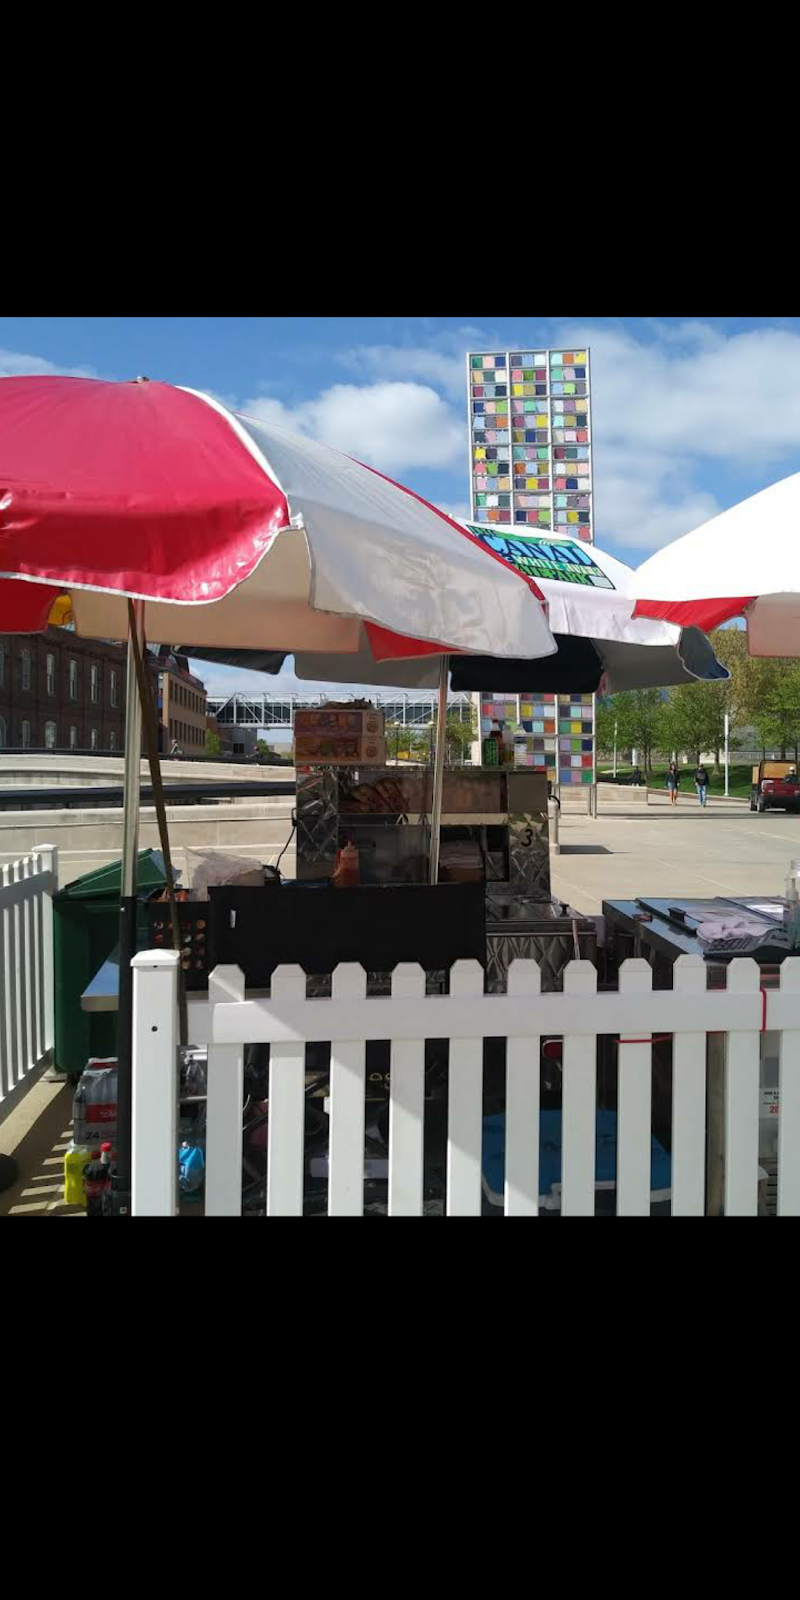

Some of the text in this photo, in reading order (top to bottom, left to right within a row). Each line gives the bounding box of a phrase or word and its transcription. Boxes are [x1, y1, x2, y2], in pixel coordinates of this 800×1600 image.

[478, 533, 598, 567] CANAL
[511, 555, 564, 571] WHITE
[551, 569, 595, 586] PARK
[521, 828, 533, 846] 3
